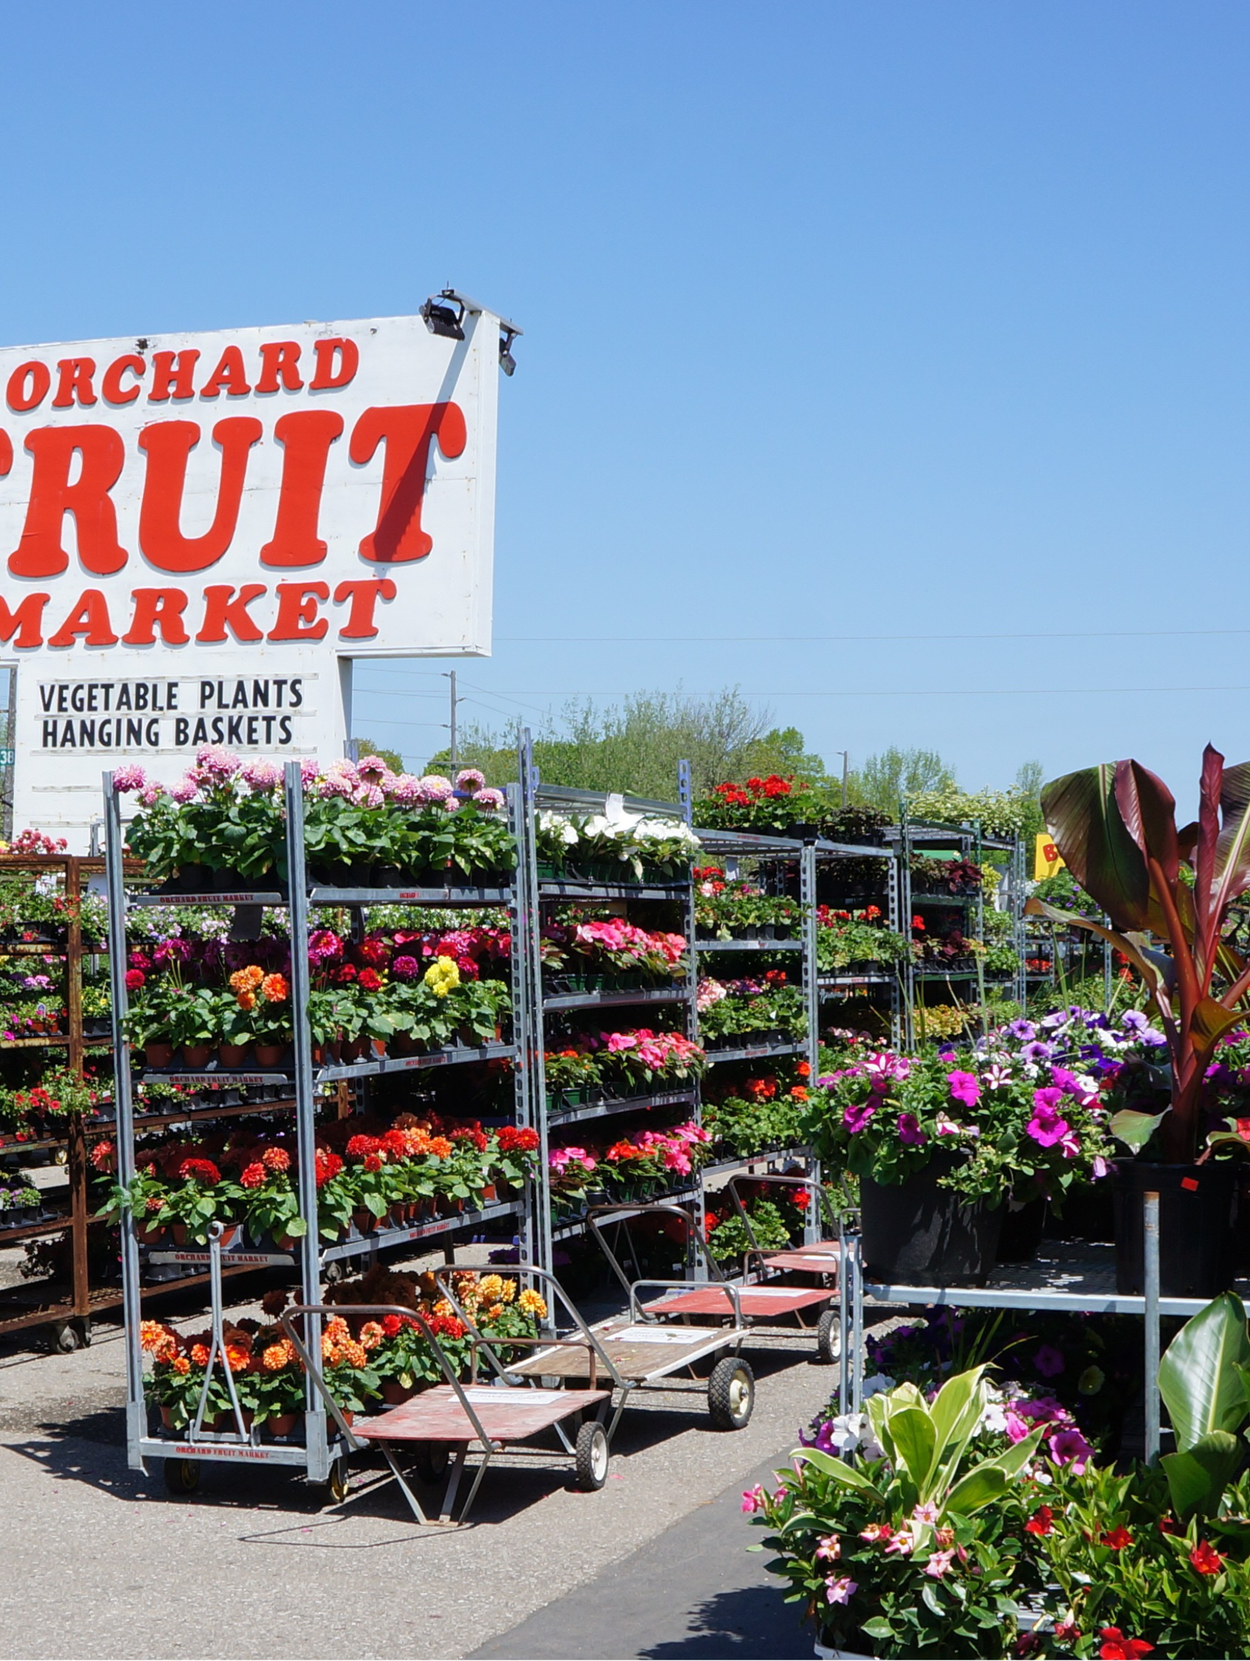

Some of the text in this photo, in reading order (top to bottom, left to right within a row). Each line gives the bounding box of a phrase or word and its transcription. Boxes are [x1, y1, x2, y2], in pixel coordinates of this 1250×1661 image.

[6, 337, 359, 412] ORCHARD
[39, 678, 303, 713] VEGETABLE PLANTS
[42, 715, 293, 748] HANGING BASKETS
[237, 1255, 268, 1263] MARKET
[175, 1446, 212, 1455] ORCHARD
[238, 1450, 270, 1459] MARKET
